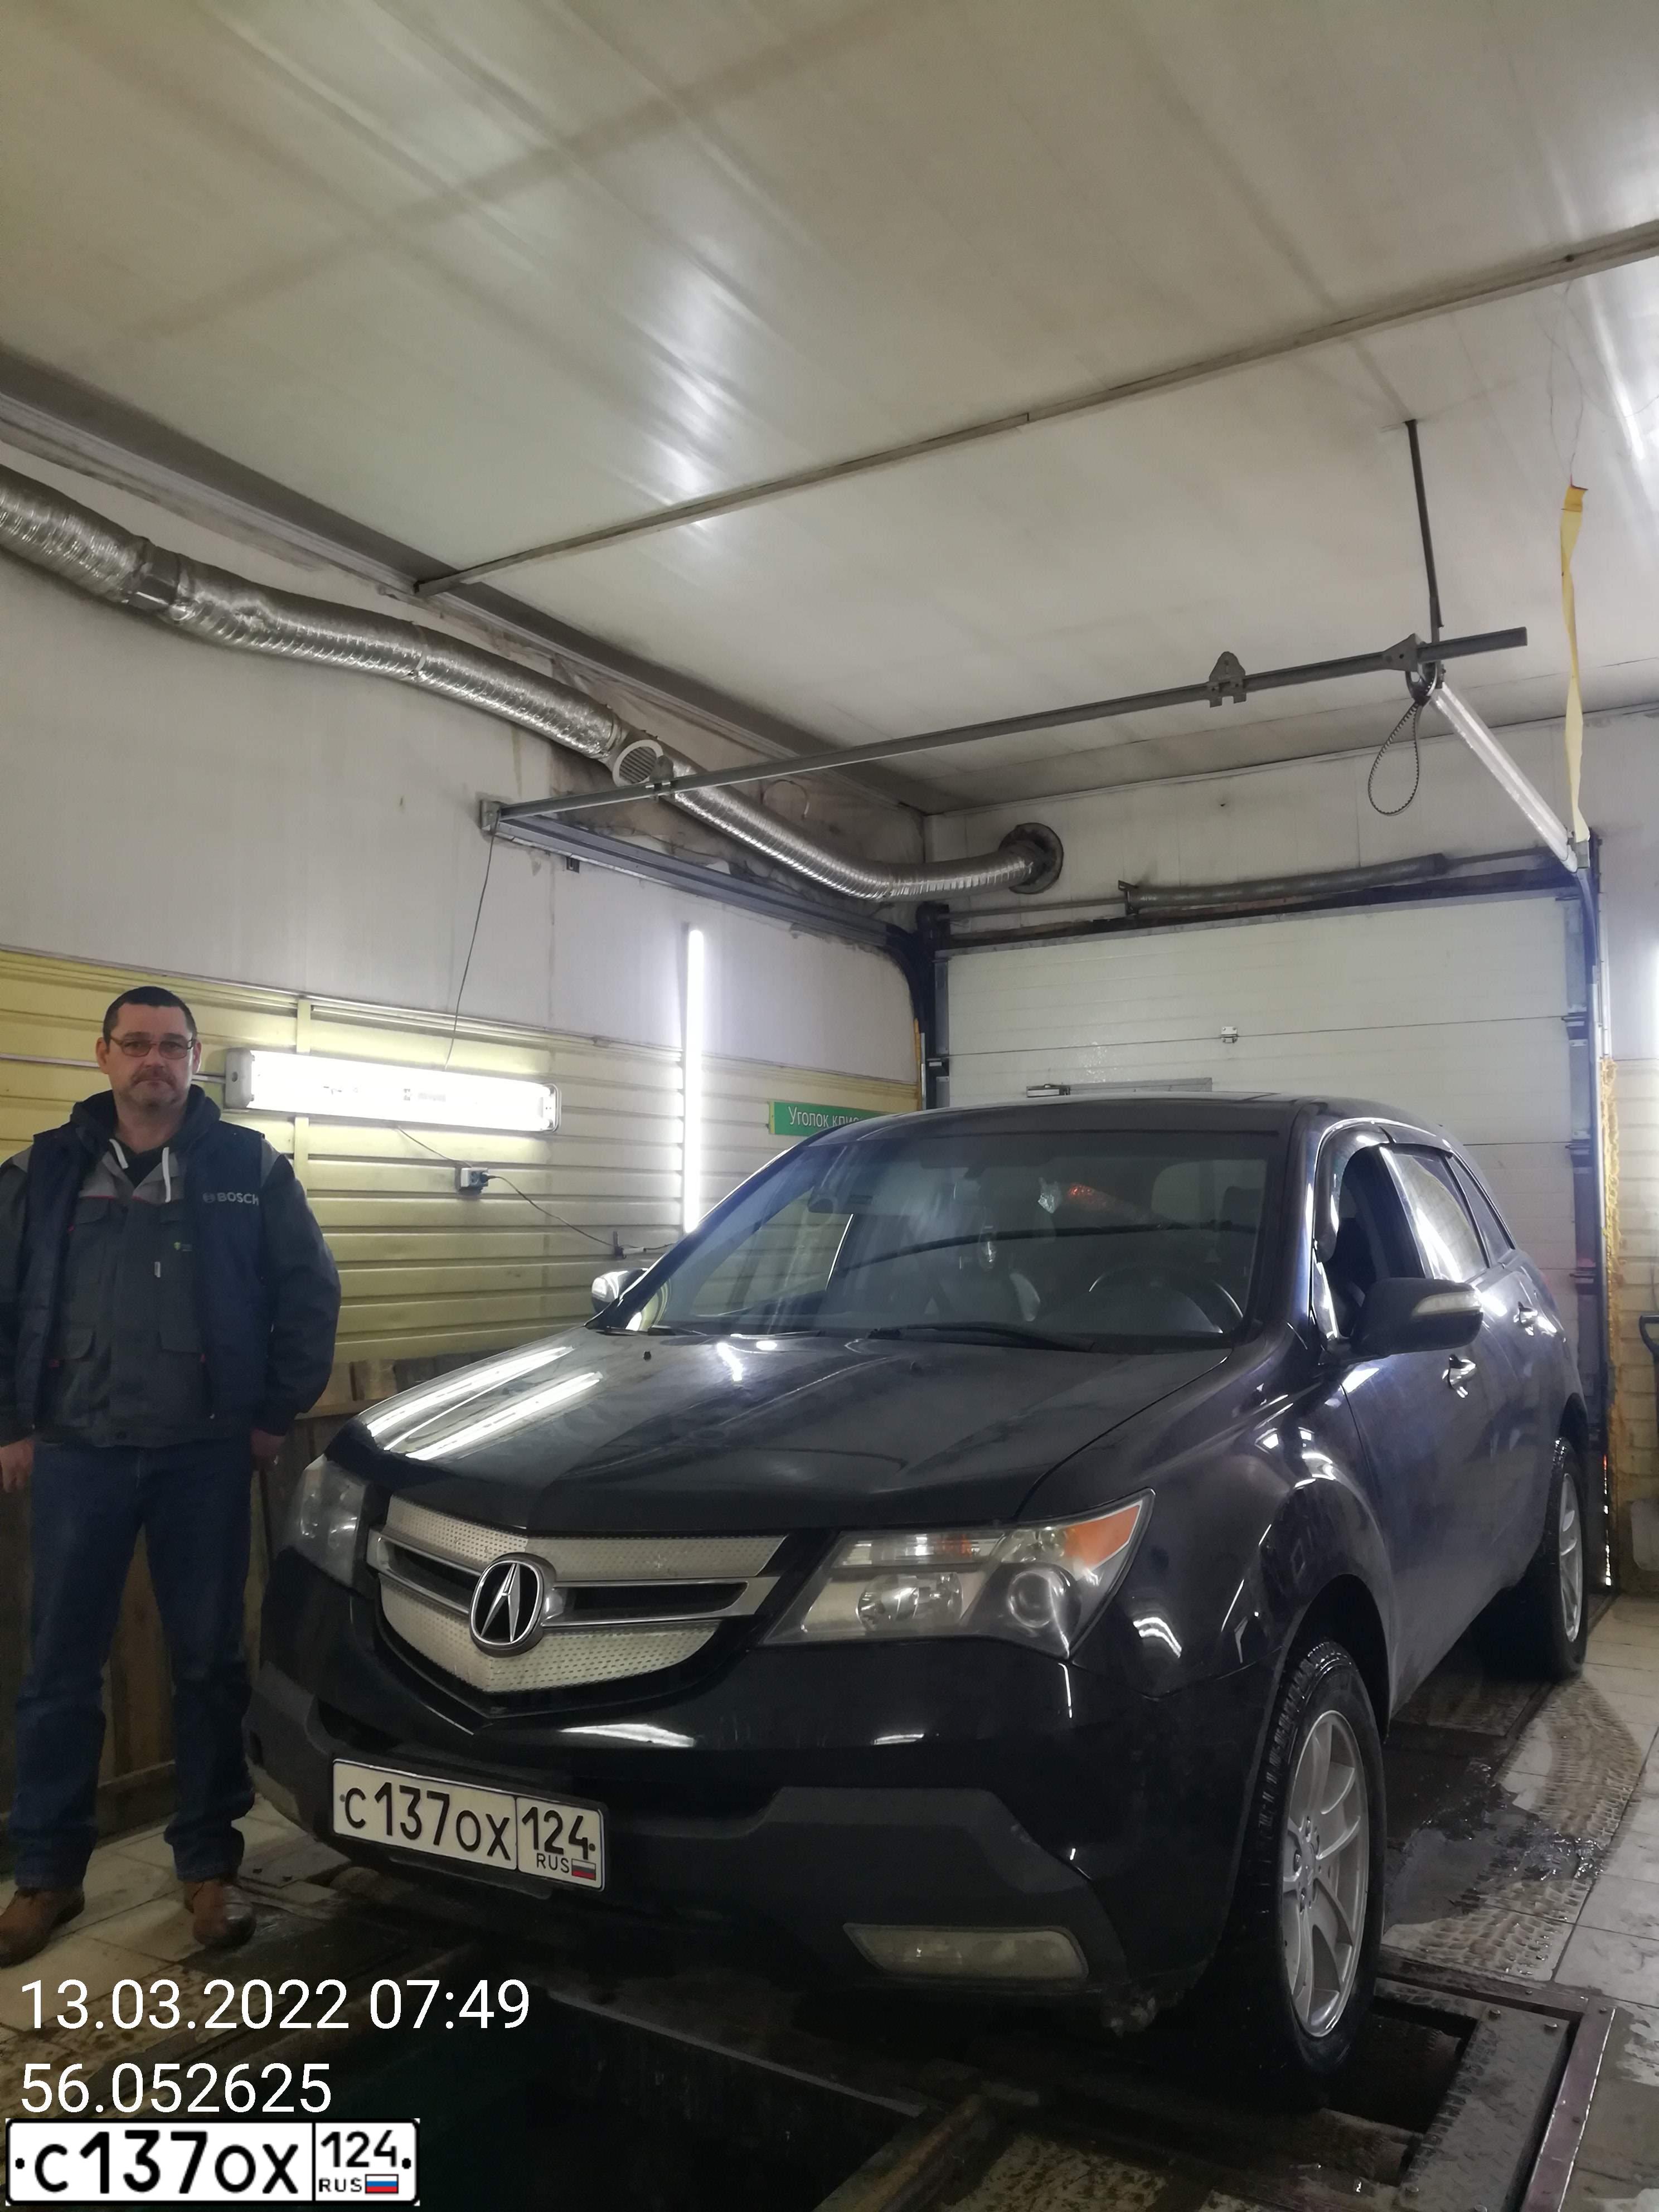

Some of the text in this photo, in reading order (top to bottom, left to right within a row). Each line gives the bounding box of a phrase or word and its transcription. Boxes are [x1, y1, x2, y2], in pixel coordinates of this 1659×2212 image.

[788, 1106, 830, 1128] Уголок
[217, 1192, 259, 1206] BOSCH
[521, 1806, 589, 1860] 124
[536, 1852, 570, 1874] RUS
